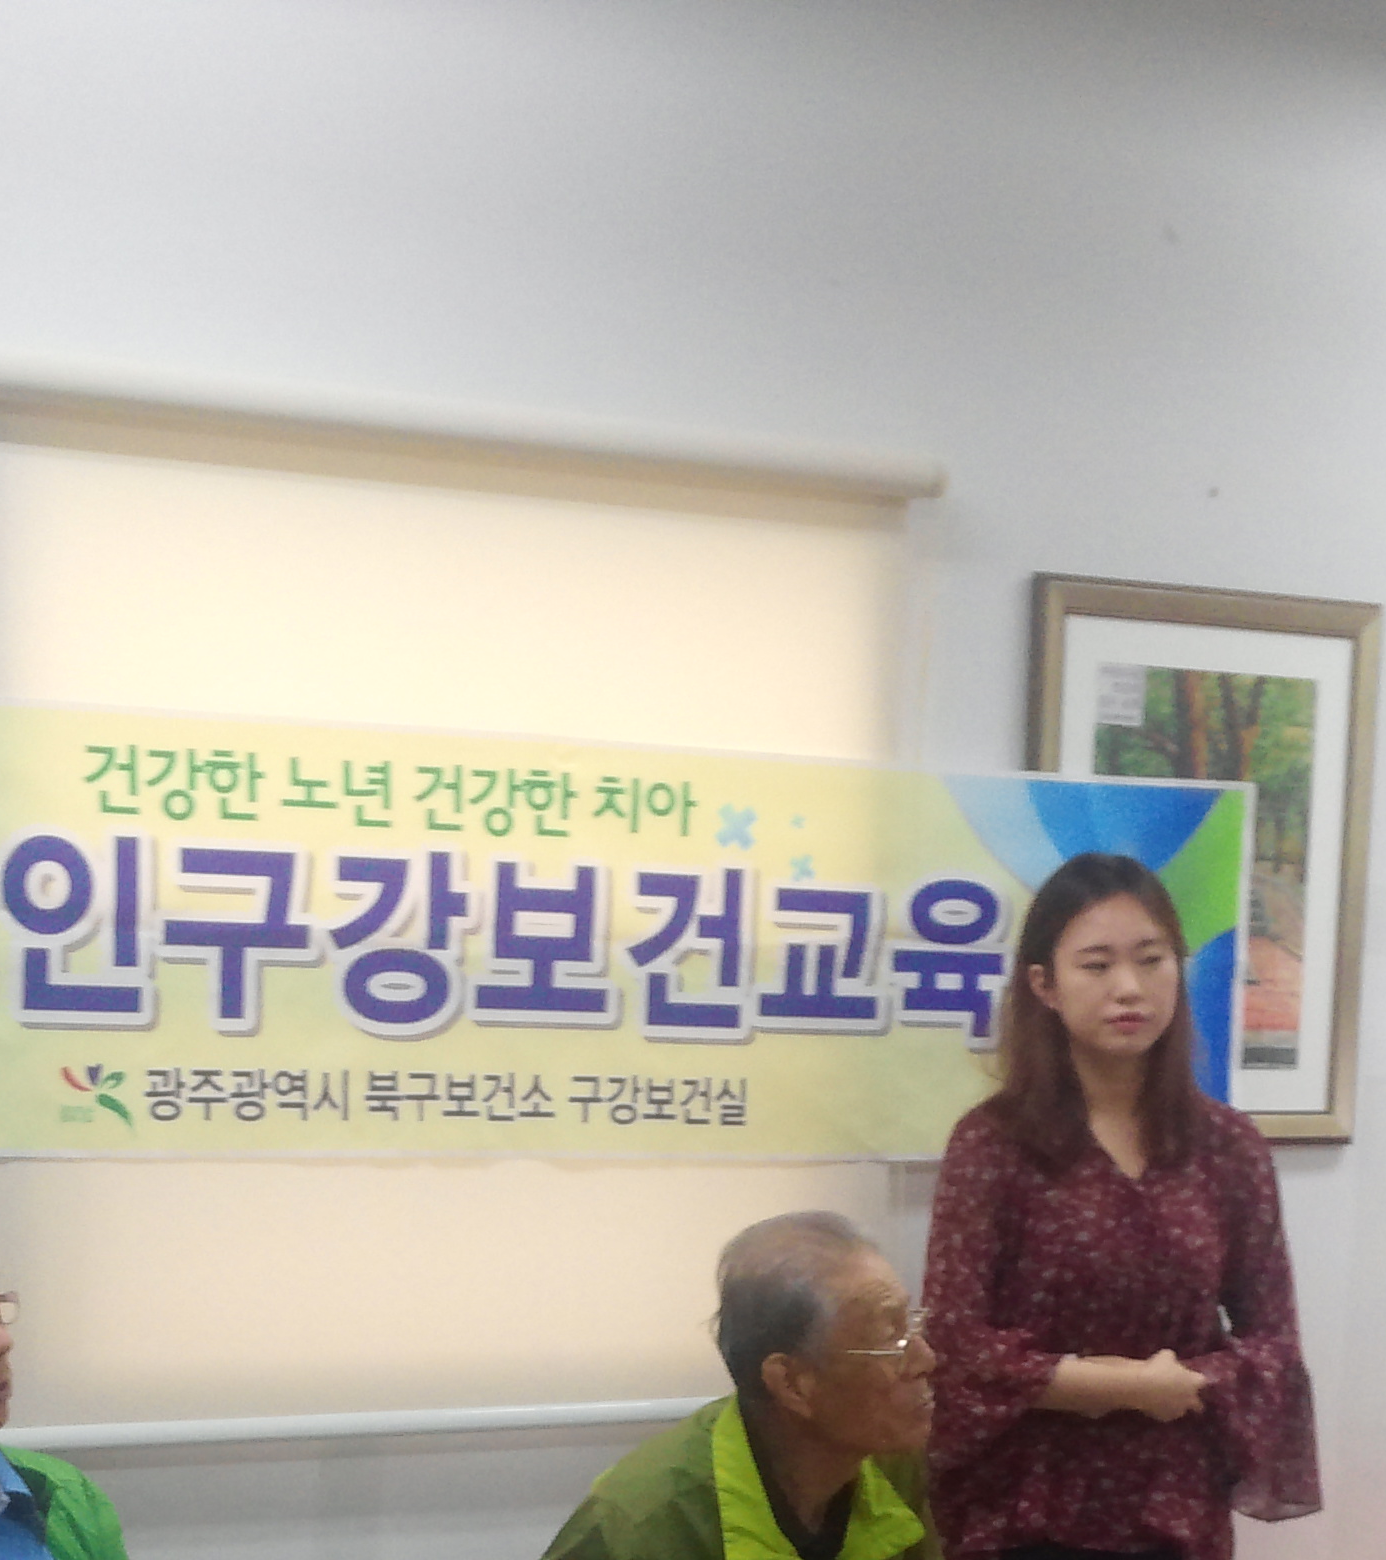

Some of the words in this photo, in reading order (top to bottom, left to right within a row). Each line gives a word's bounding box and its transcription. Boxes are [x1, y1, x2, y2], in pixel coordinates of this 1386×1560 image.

[85, 743, 266, 823] 건강한
[281, 756, 393, 829] 노년
[414, 763, 577, 839] 건강한
[592, 773, 698, 838] 치아
[143, 1066, 351, 1124] 광주광역시
[364, 1069, 557, 1126] 북구보건소
[567, 1073, 748, 1128] 구강보건실
